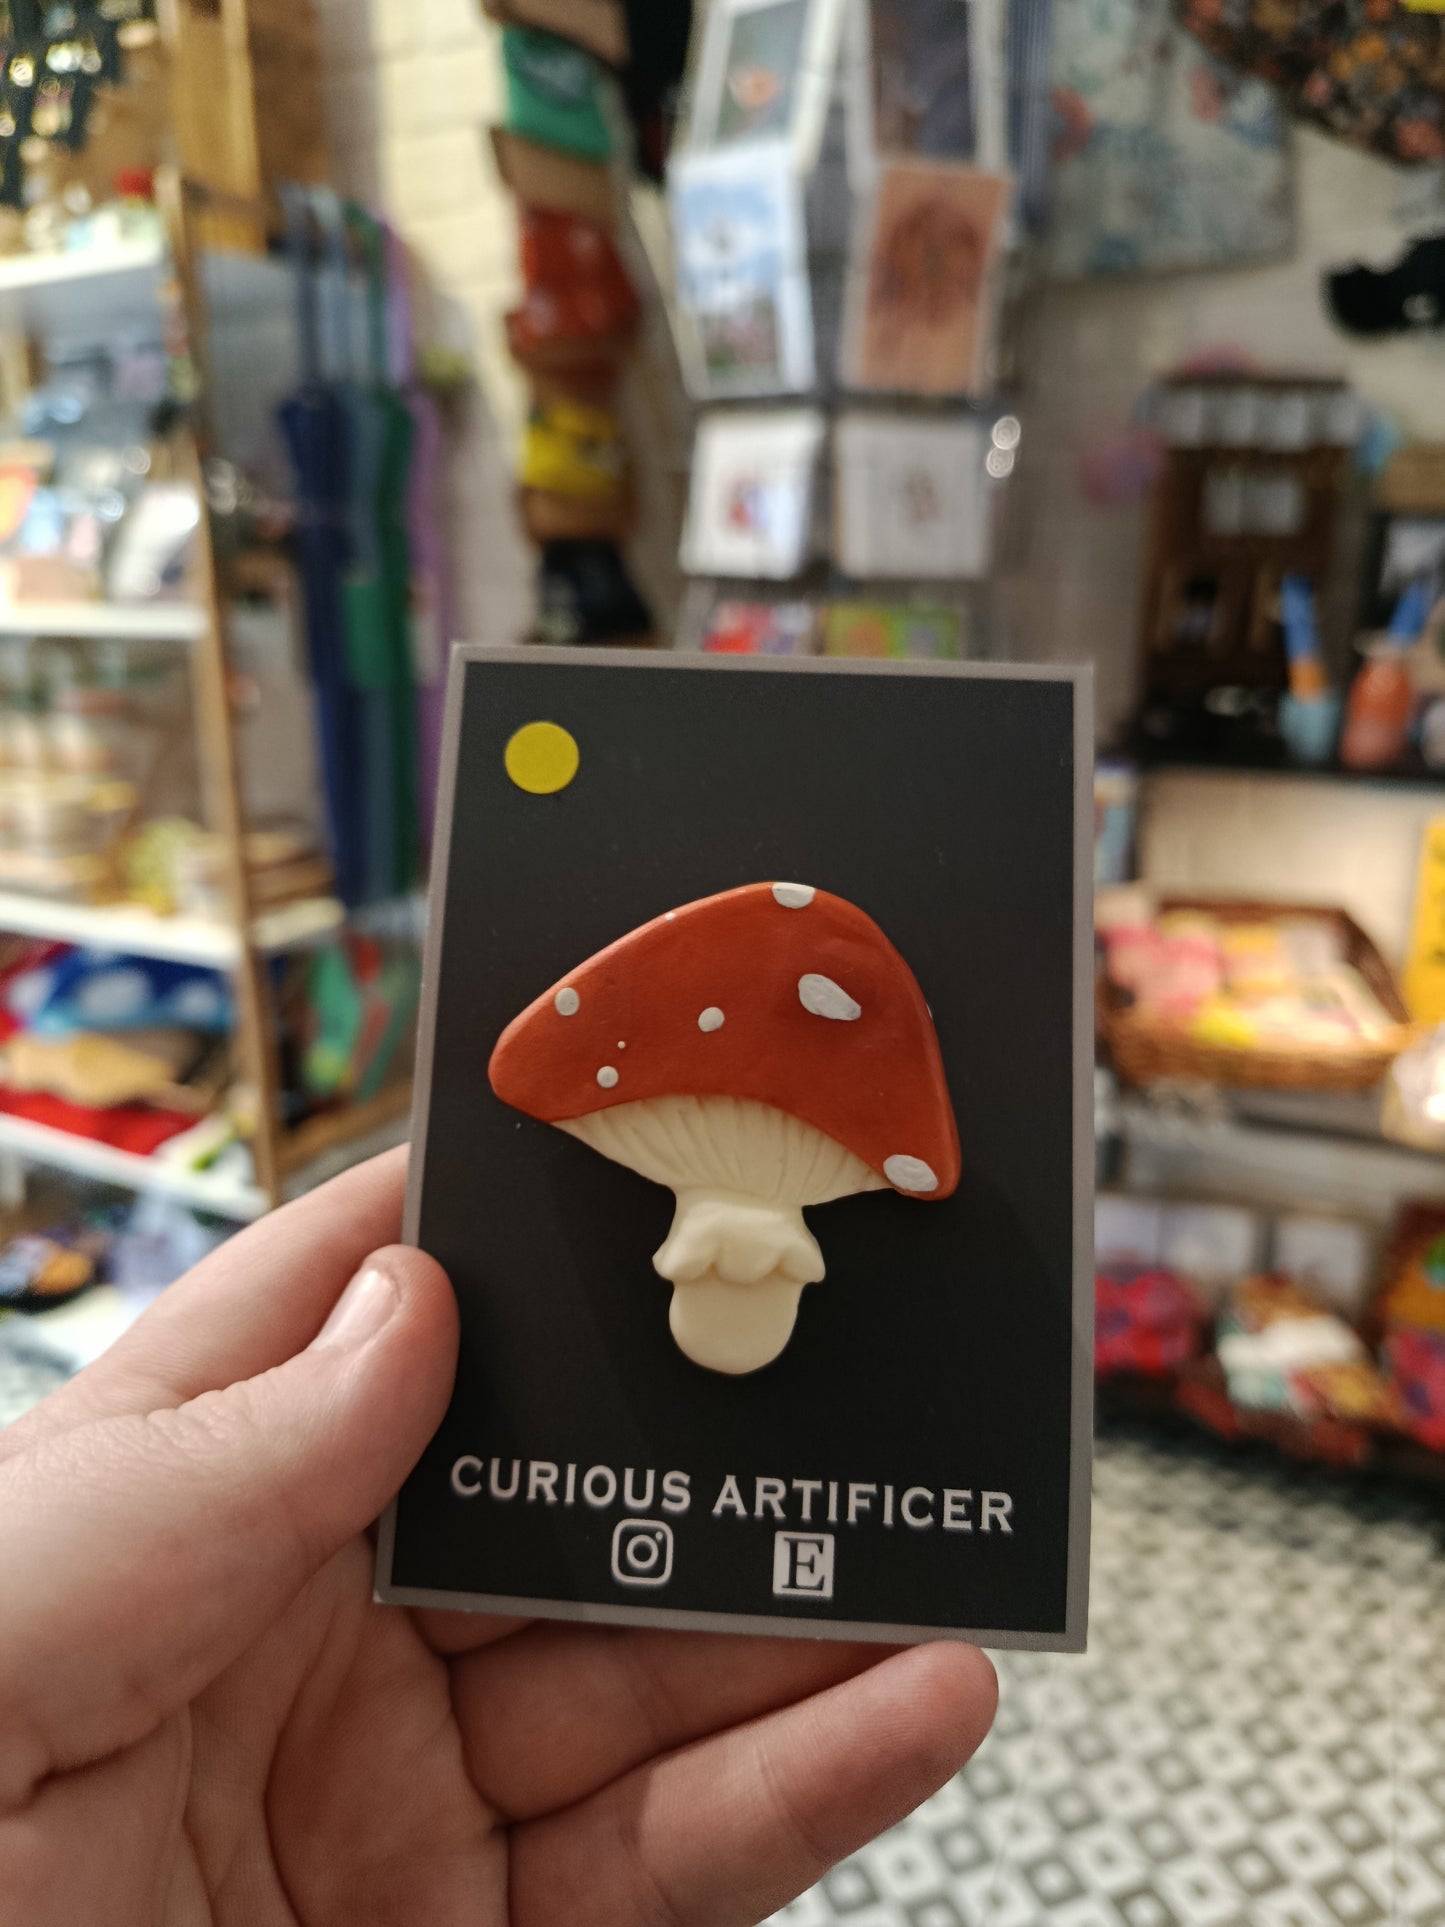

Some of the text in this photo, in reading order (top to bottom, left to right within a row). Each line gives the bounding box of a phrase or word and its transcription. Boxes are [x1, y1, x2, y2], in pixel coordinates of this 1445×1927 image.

[451, 1455, 1014, 1533] CURIOUS ARTIFICER
[781, 1536, 826, 1592] E
